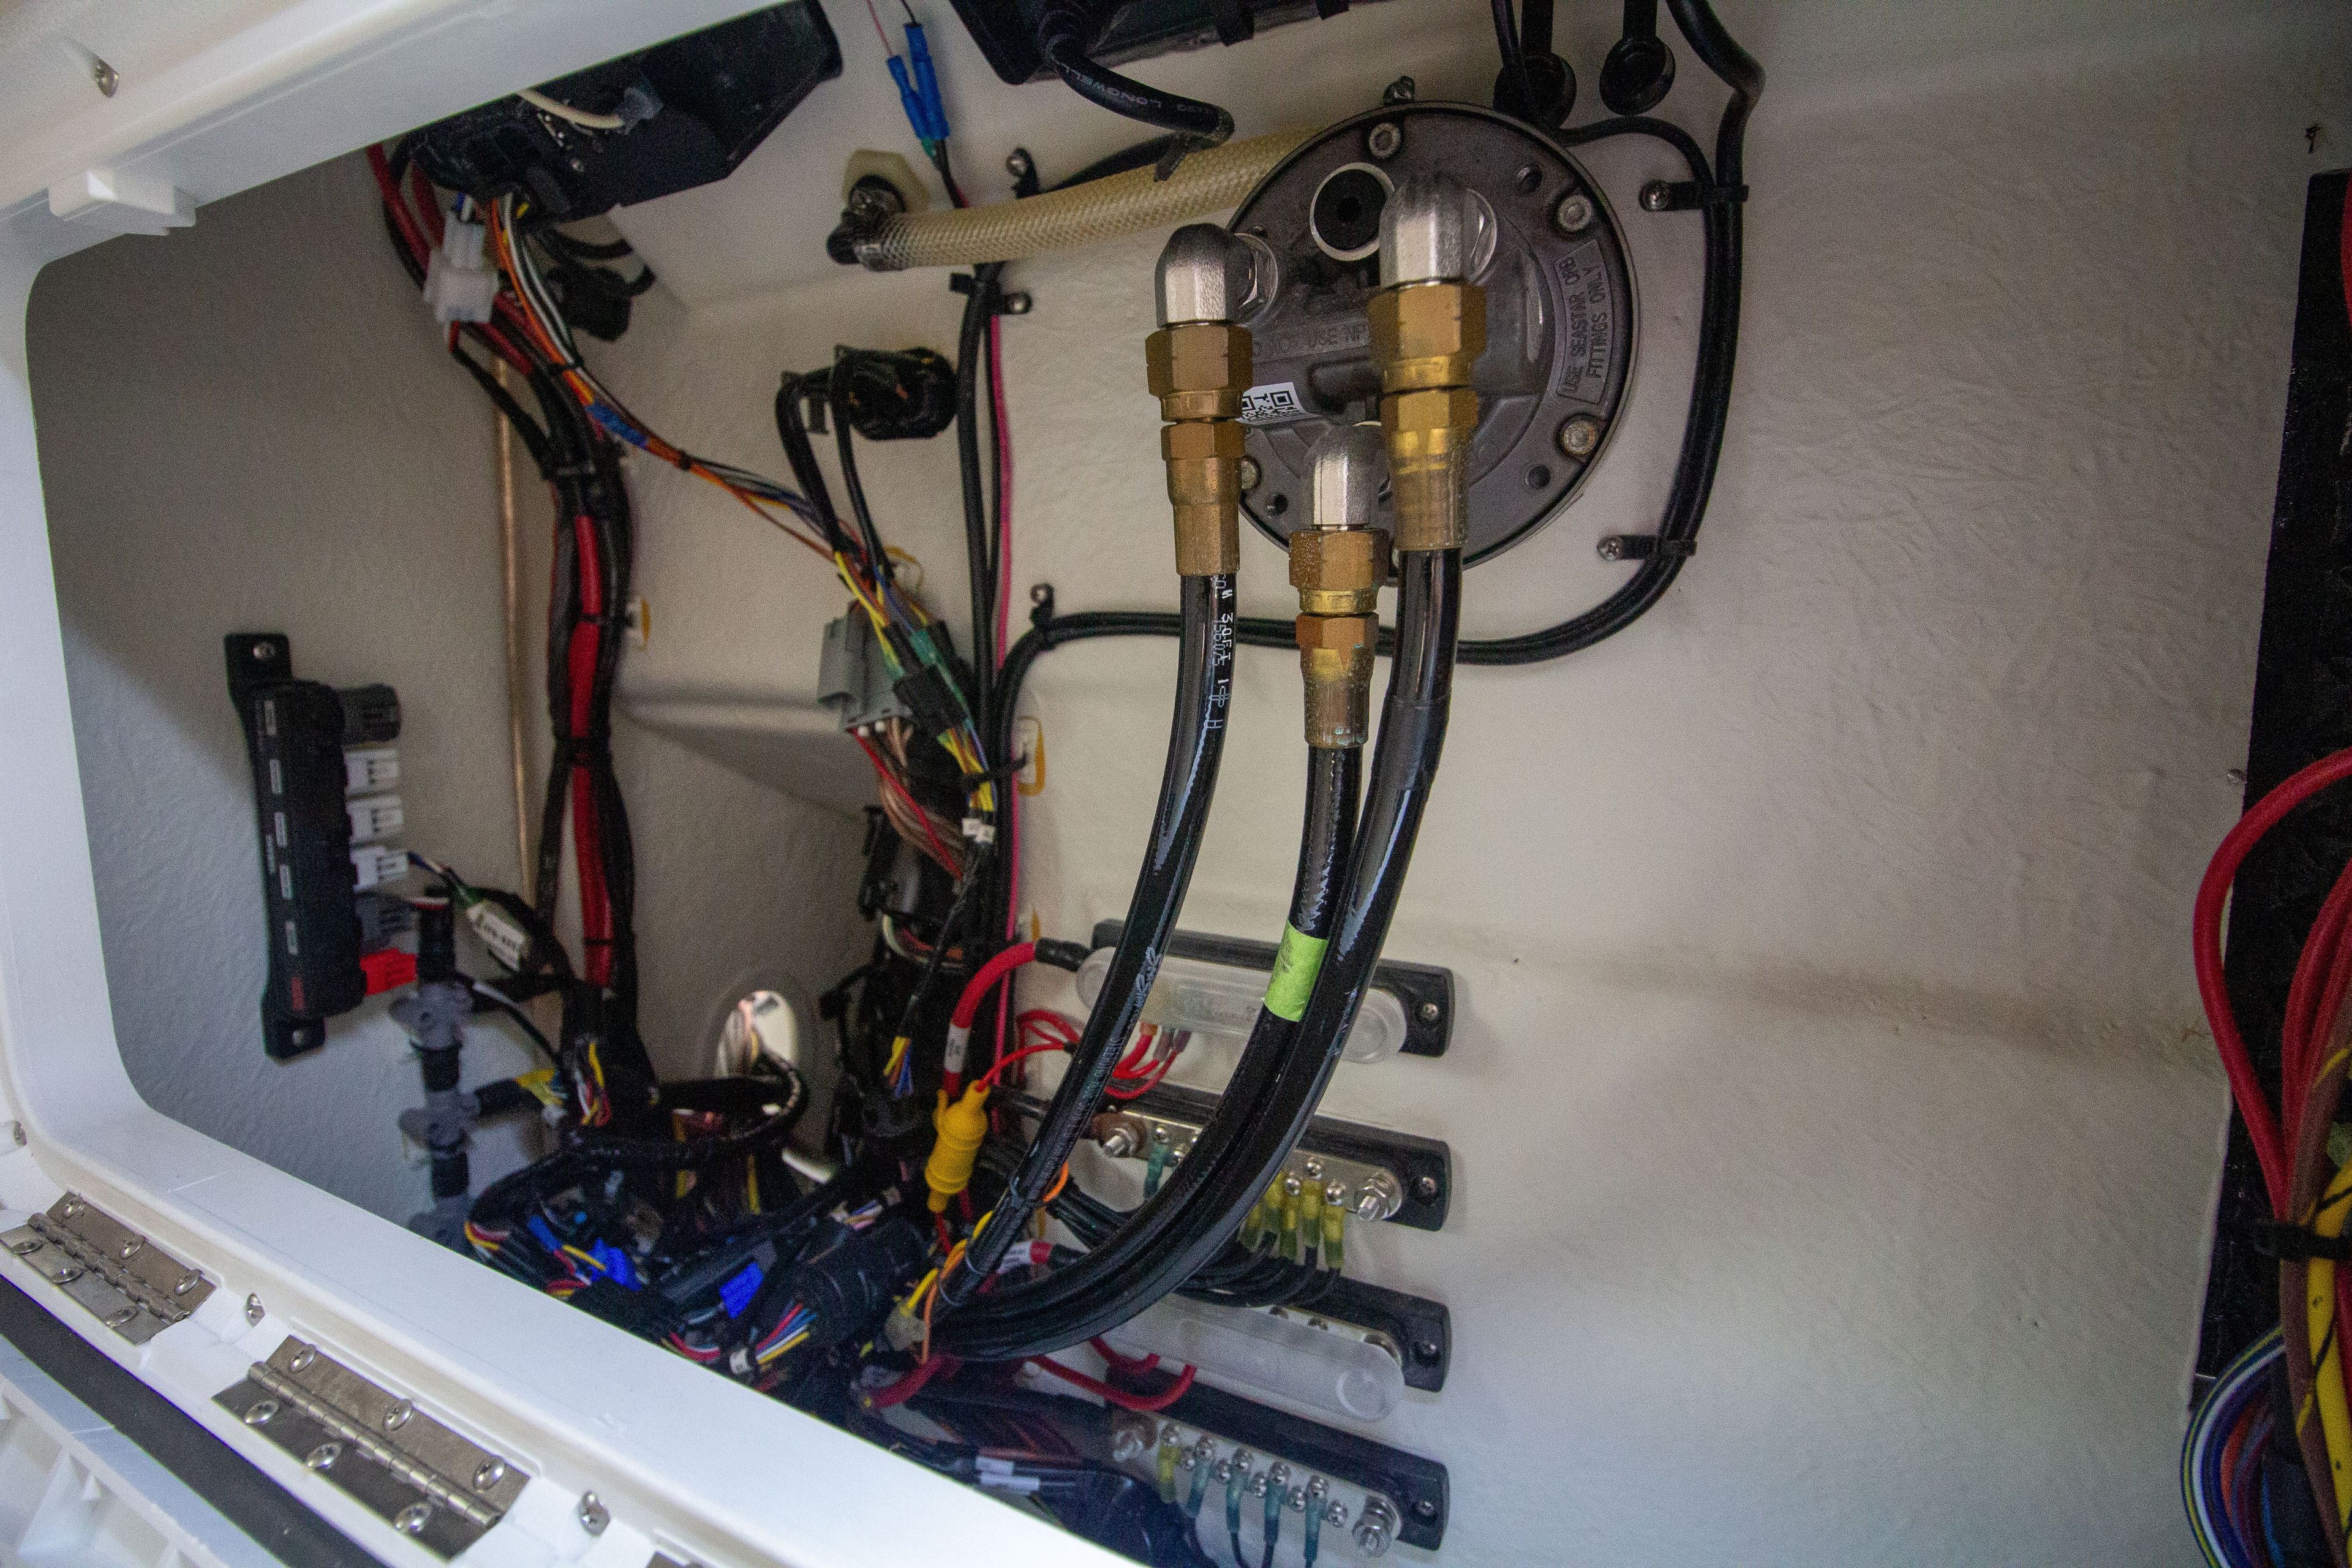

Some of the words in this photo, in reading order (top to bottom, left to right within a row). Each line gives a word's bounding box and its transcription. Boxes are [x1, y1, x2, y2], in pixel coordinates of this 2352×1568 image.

[1559, 257, 1580, 285] ORB
[1583, 265, 1606, 304] ONLY
[1306, 326, 1338, 349] USE
[1344, 323, 1369, 342] NP
[1569, 292, 1588, 356] SEASTAR
[1586, 312, 1608, 379] FITTINGS
[1562, 365, 1583, 394] USE
